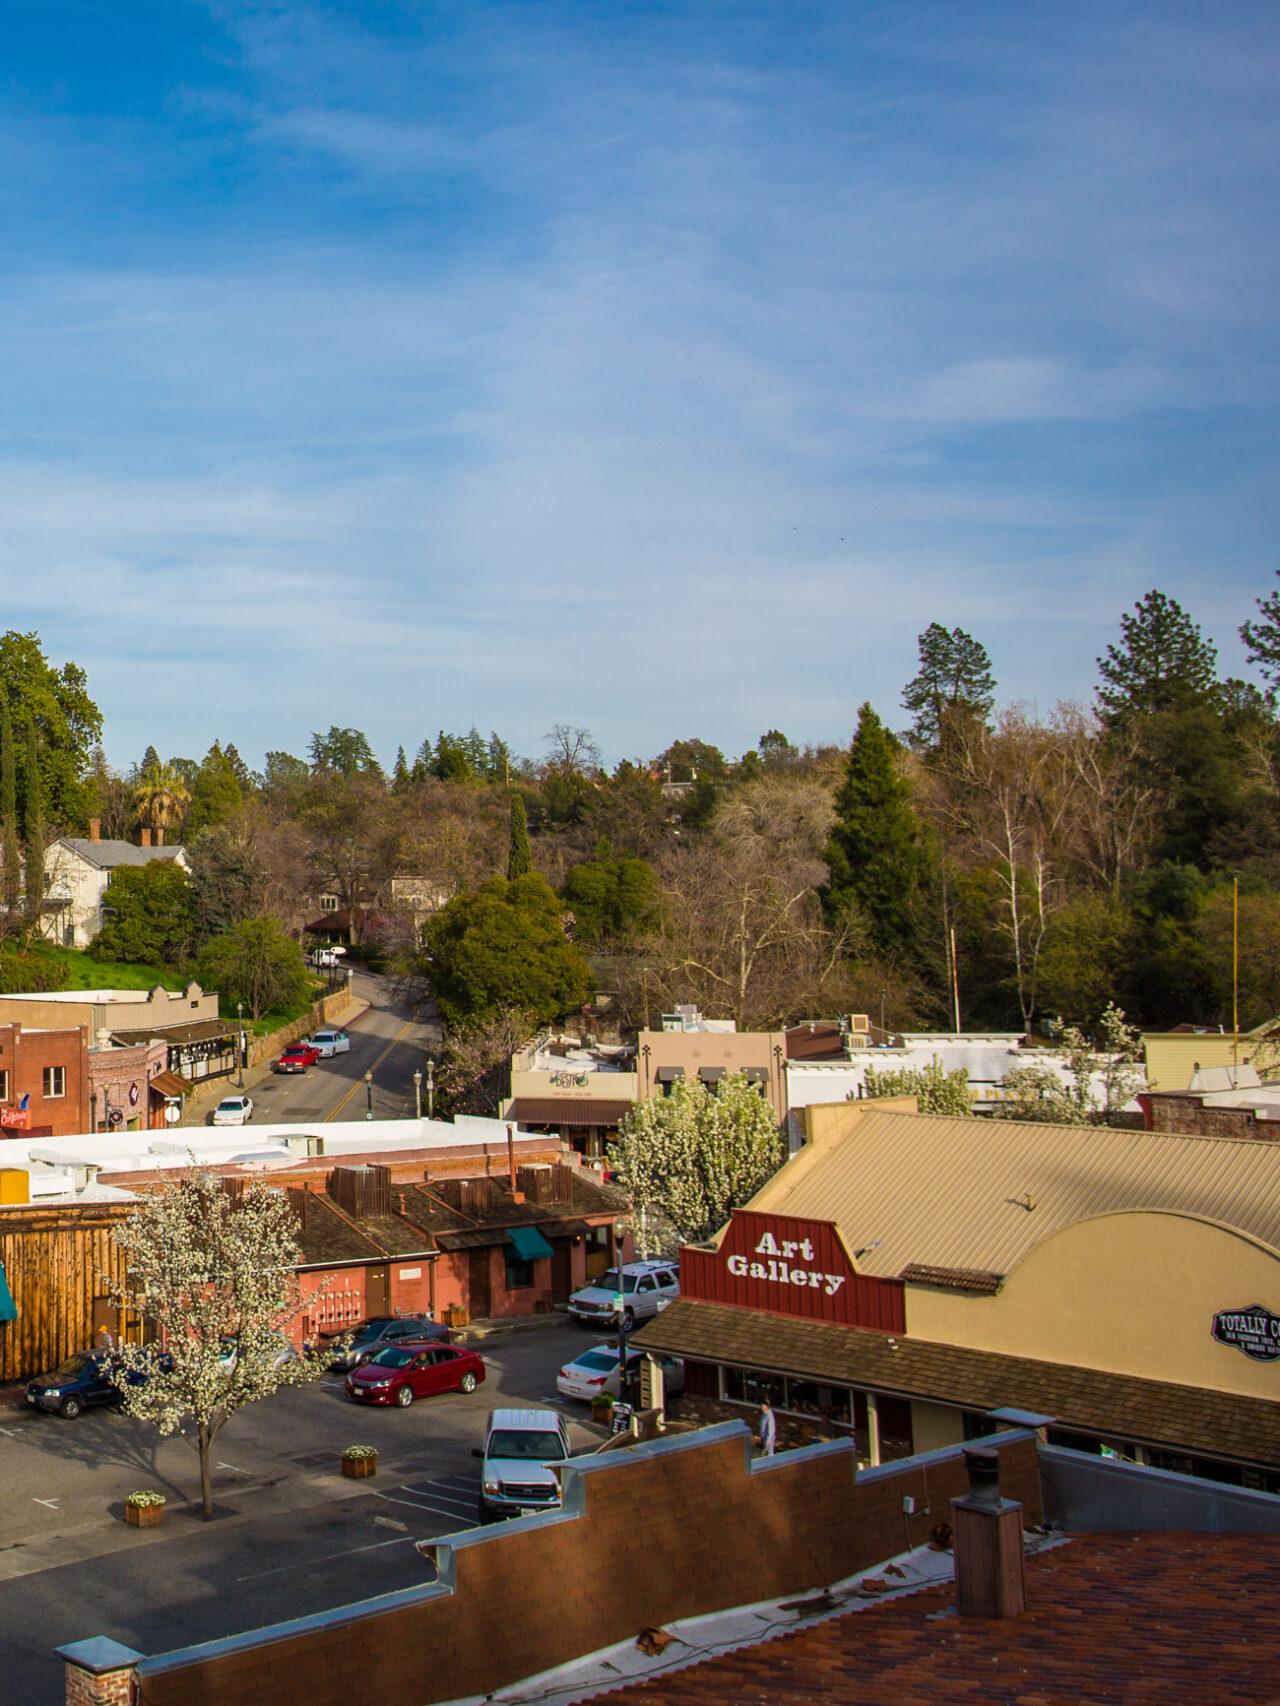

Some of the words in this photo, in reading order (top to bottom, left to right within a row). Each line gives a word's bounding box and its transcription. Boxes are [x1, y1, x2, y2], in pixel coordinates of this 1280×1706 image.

[755, 1232, 814, 1261] Art
[727, 1254, 846, 1296] Gallery
[1219, 1314, 1268, 1336] TOTALLY
